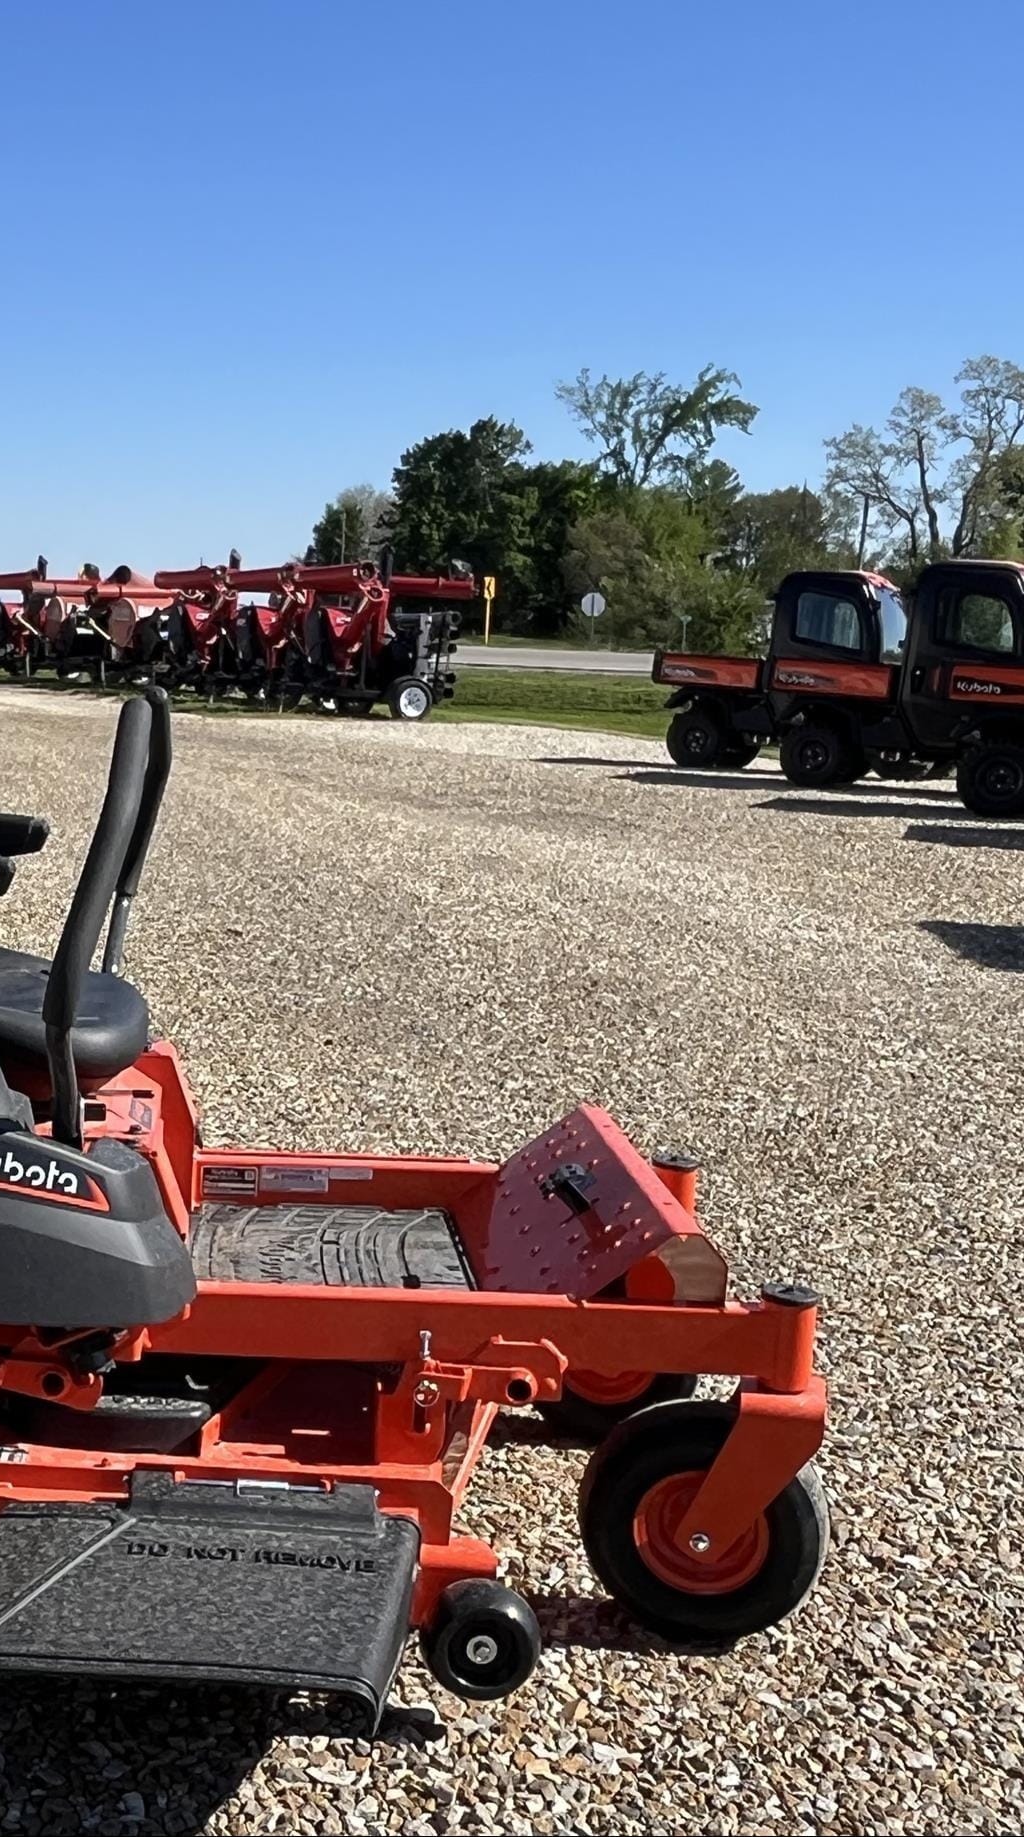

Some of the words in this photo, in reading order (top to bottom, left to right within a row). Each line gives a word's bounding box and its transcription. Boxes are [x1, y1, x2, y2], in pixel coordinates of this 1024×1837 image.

[957, 681, 1001, 694] Kubota
[127, 1542, 168, 1558] DO
[187, 1547, 245, 1562] NOT
[254, 1550, 377, 1573] REMOVE
